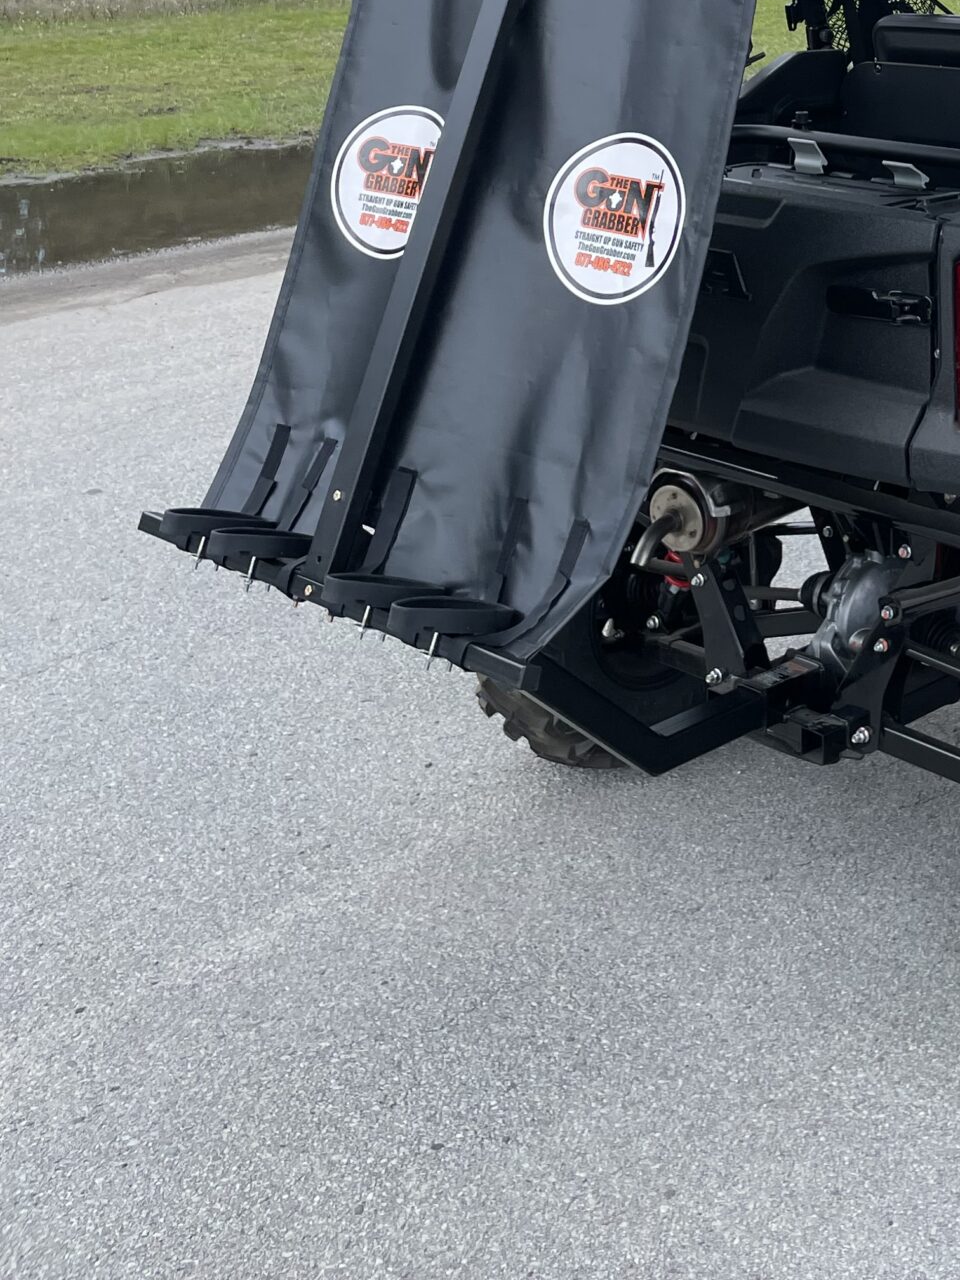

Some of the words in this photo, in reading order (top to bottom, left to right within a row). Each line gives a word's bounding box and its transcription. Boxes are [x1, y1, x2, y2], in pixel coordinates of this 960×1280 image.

[391, 145, 410, 157] THE
[365, 173, 417, 197] GRABBER
[610, 177, 629, 190] THE
[358, 193, 385, 206] STRAIGHT
[576, 169, 663, 224] GUN
[582, 209, 639, 235] GRABBER
[575, 230, 603, 244] STRAIGHT
[612, 237, 624, 248] GUN
[624, 240, 644, 252] SAFETY
[578, 241, 636, 261] TheGunGrabber.com
